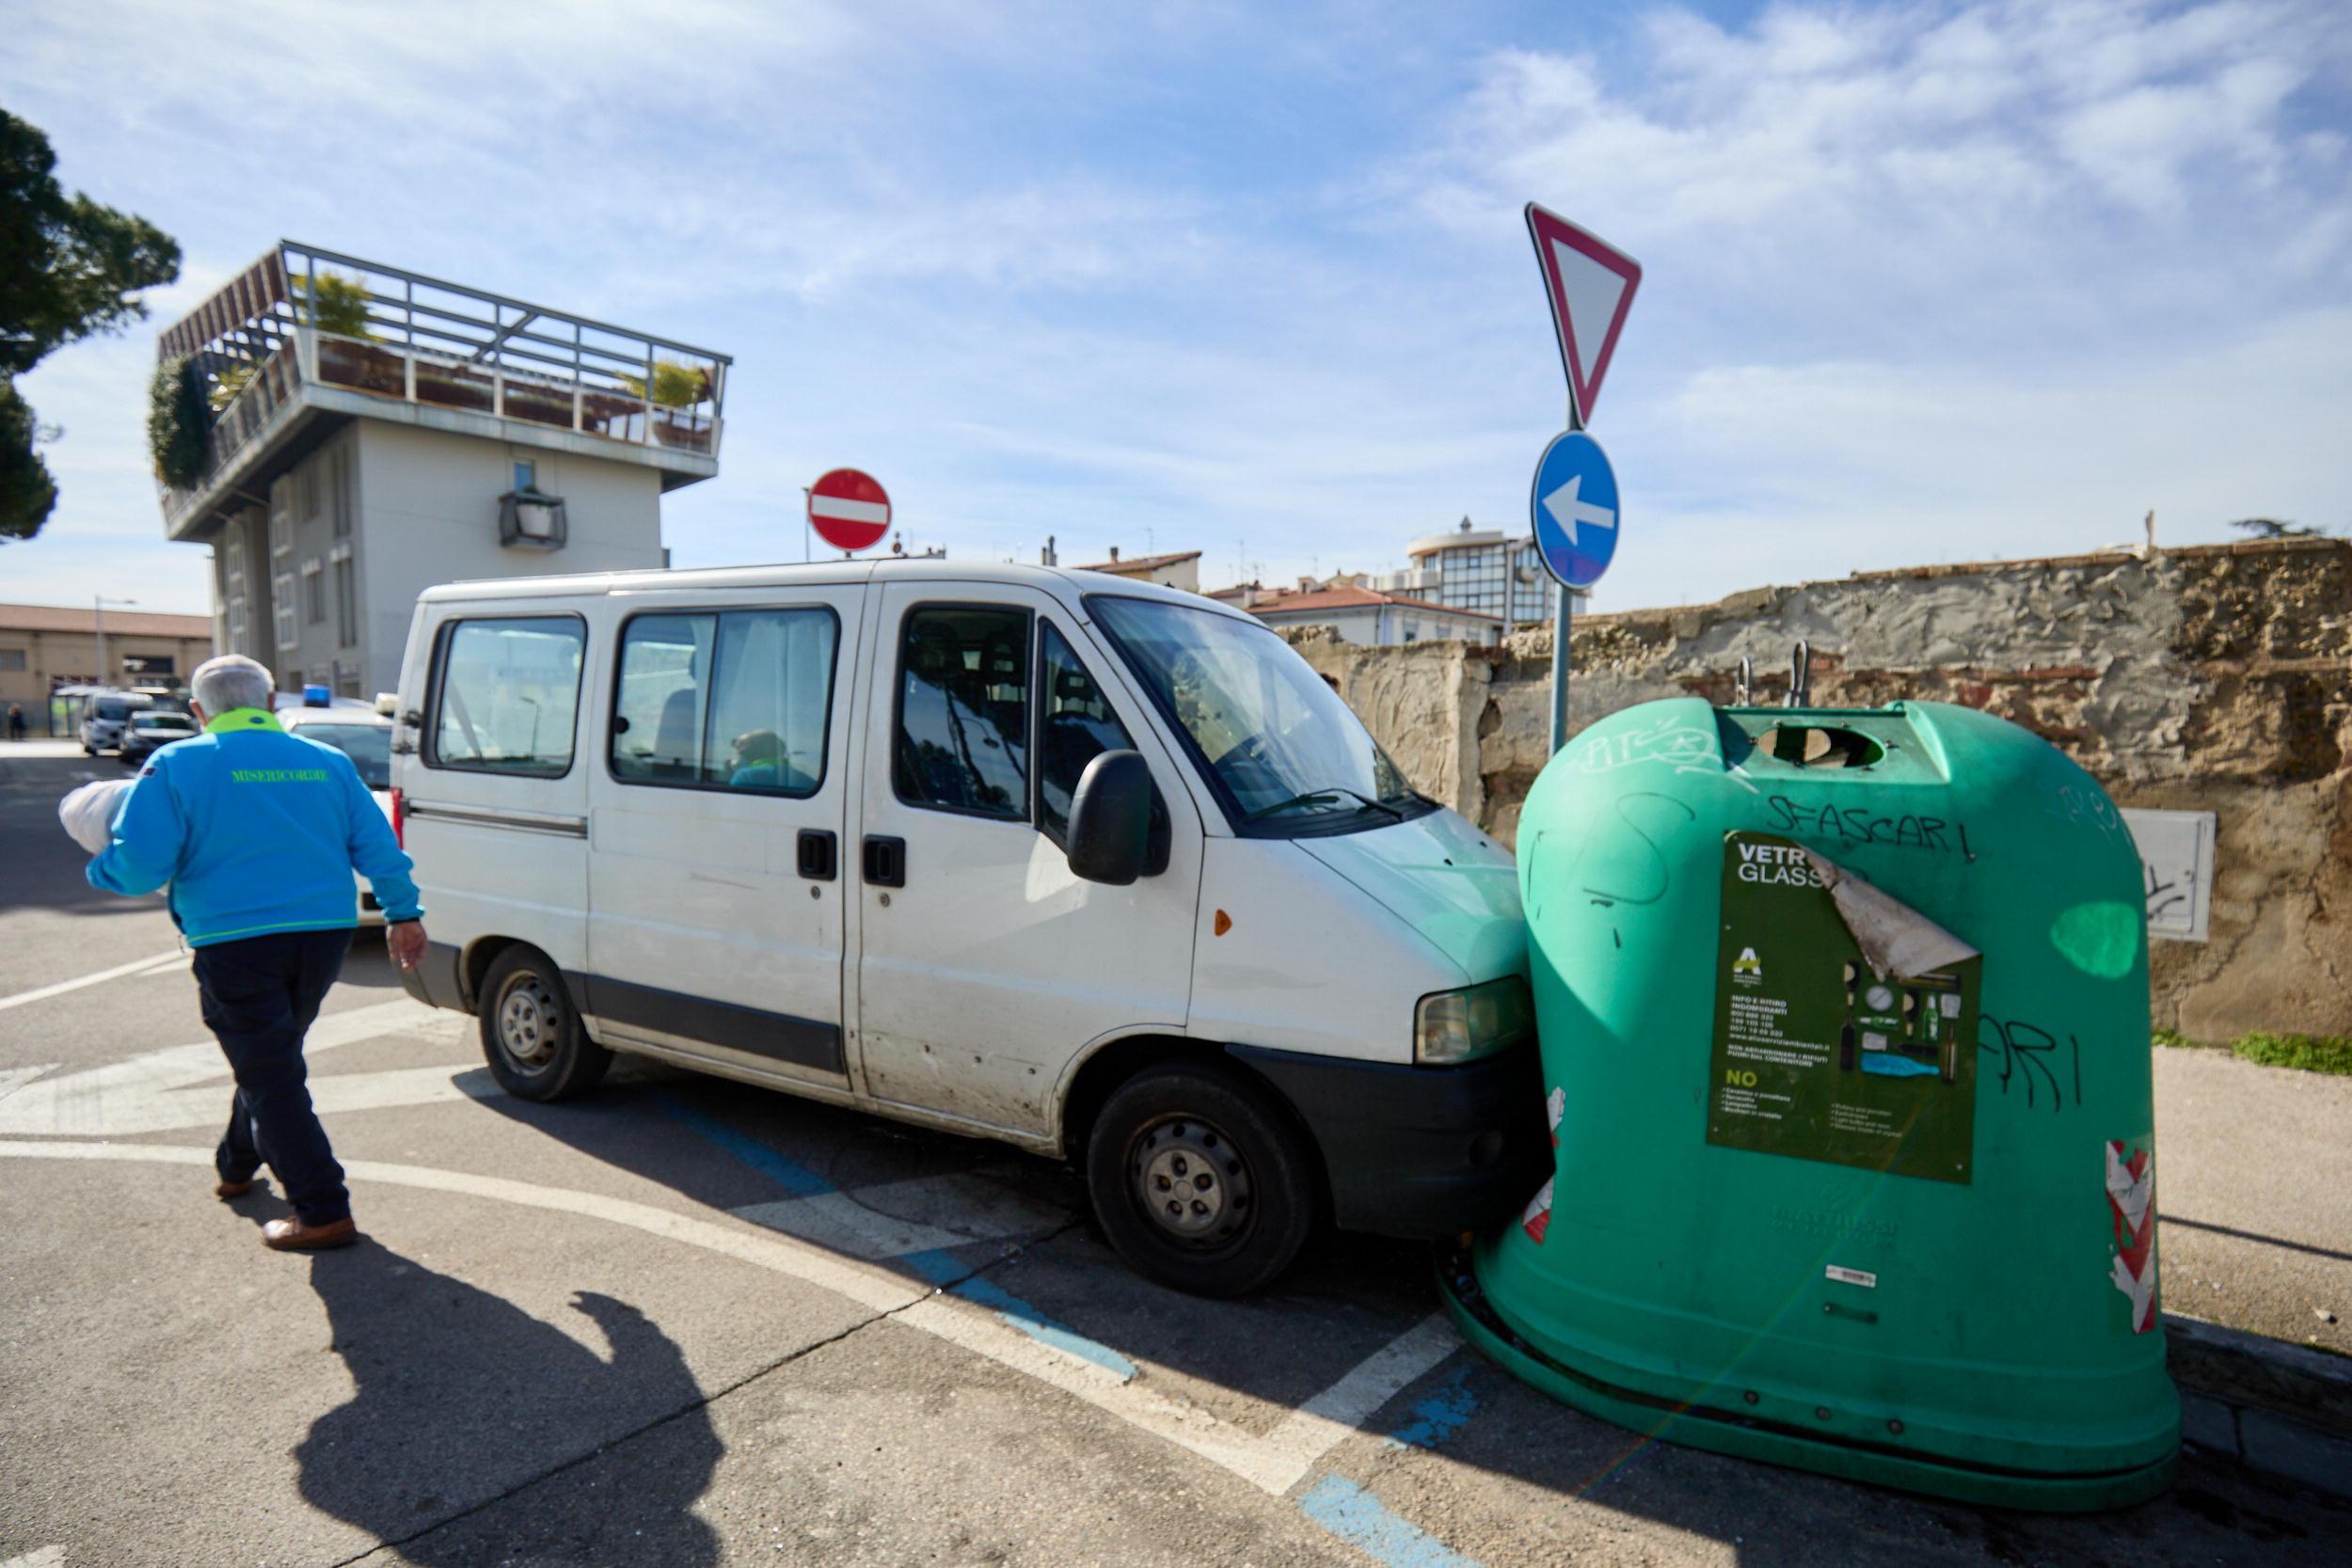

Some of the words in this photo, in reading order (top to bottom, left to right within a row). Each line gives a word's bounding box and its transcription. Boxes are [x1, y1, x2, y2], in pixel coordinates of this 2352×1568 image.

[230, 768, 328, 784] MISERICORDIE
[1739, 843, 1806, 866] VETR
[1738, 863, 1824, 889] GLASS
[1725, 1069, 1757, 1087] NO
